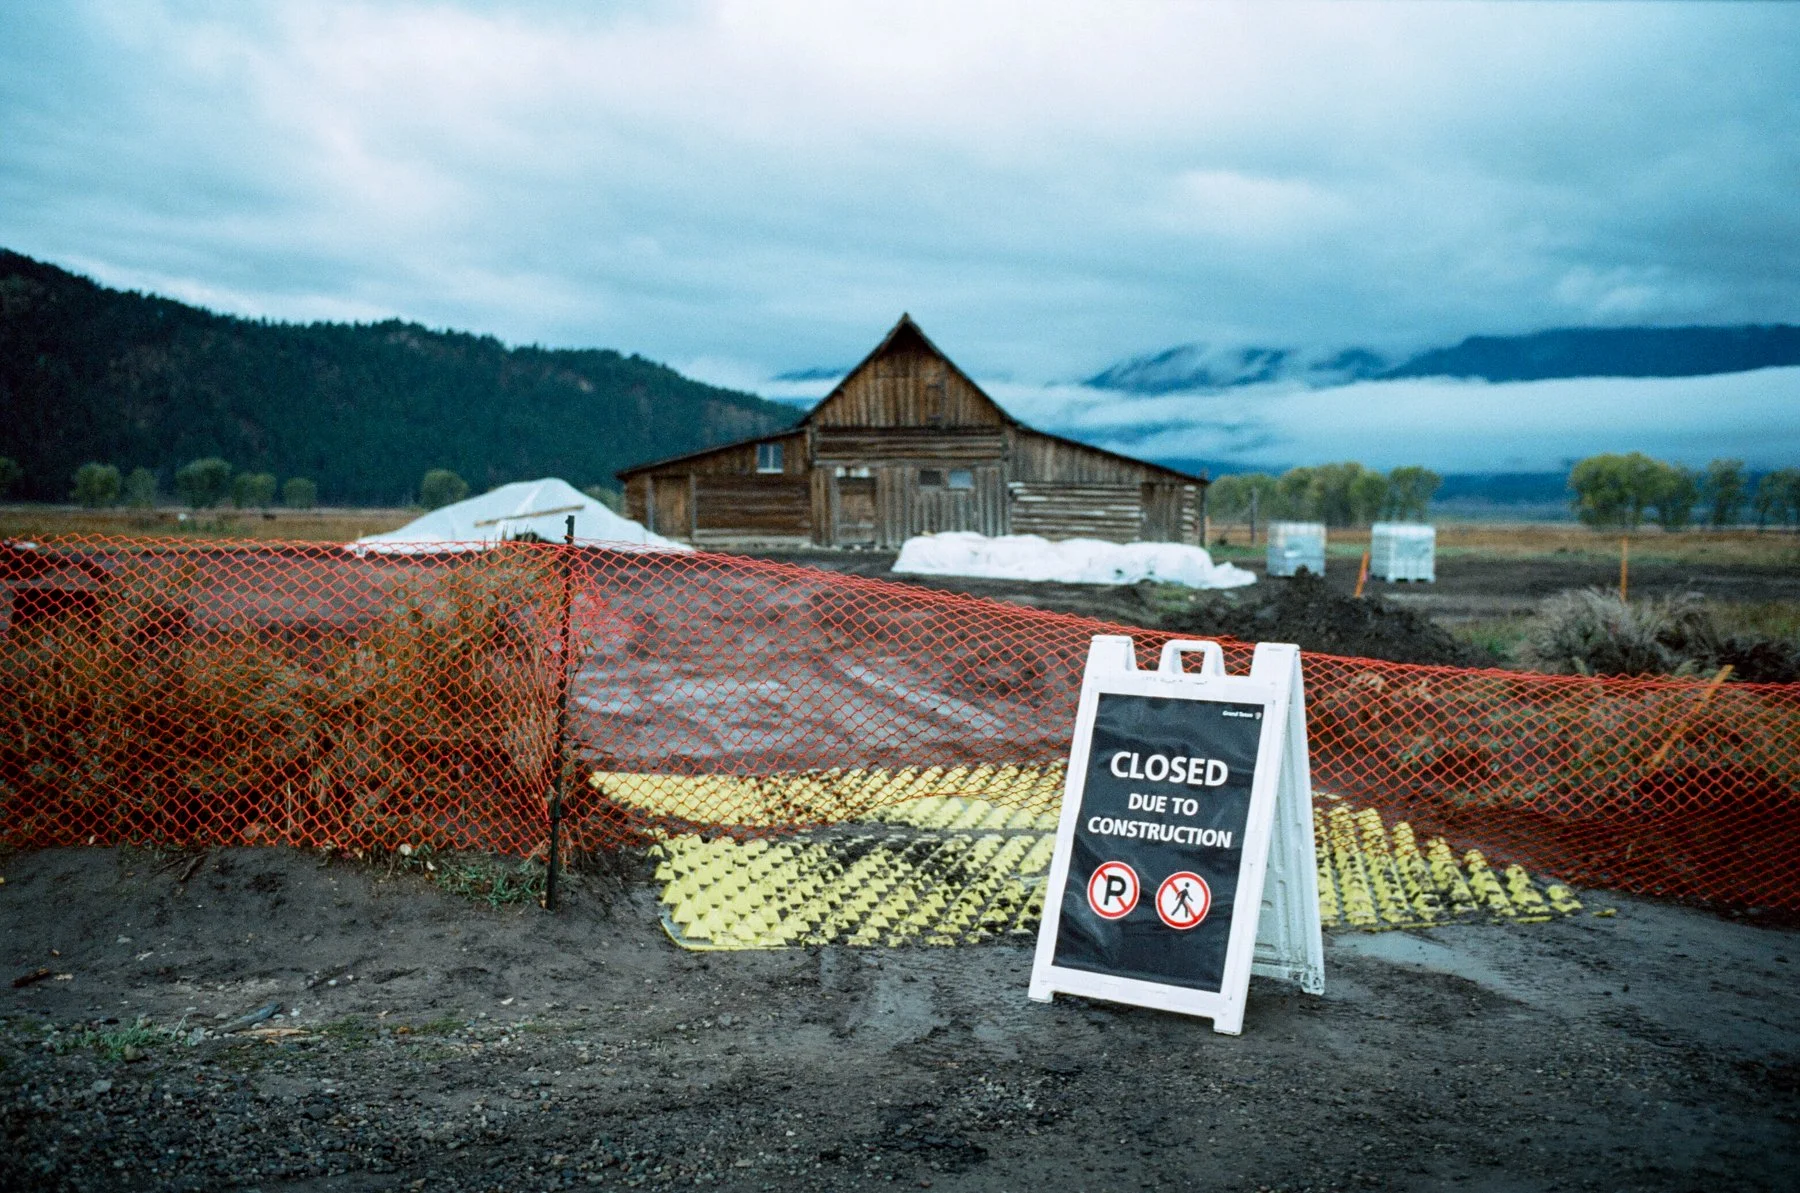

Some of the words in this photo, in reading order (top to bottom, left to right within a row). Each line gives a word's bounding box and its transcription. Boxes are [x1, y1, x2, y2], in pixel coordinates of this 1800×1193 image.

[1110, 751, 1228, 787] CLOSED
[1128, 793, 1167, 812] DUE
[1172, 797, 1199, 816] TO
[1088, 817, 1232, 848] CONSTRUCTION
[1104, 875, 1127, 906] P
